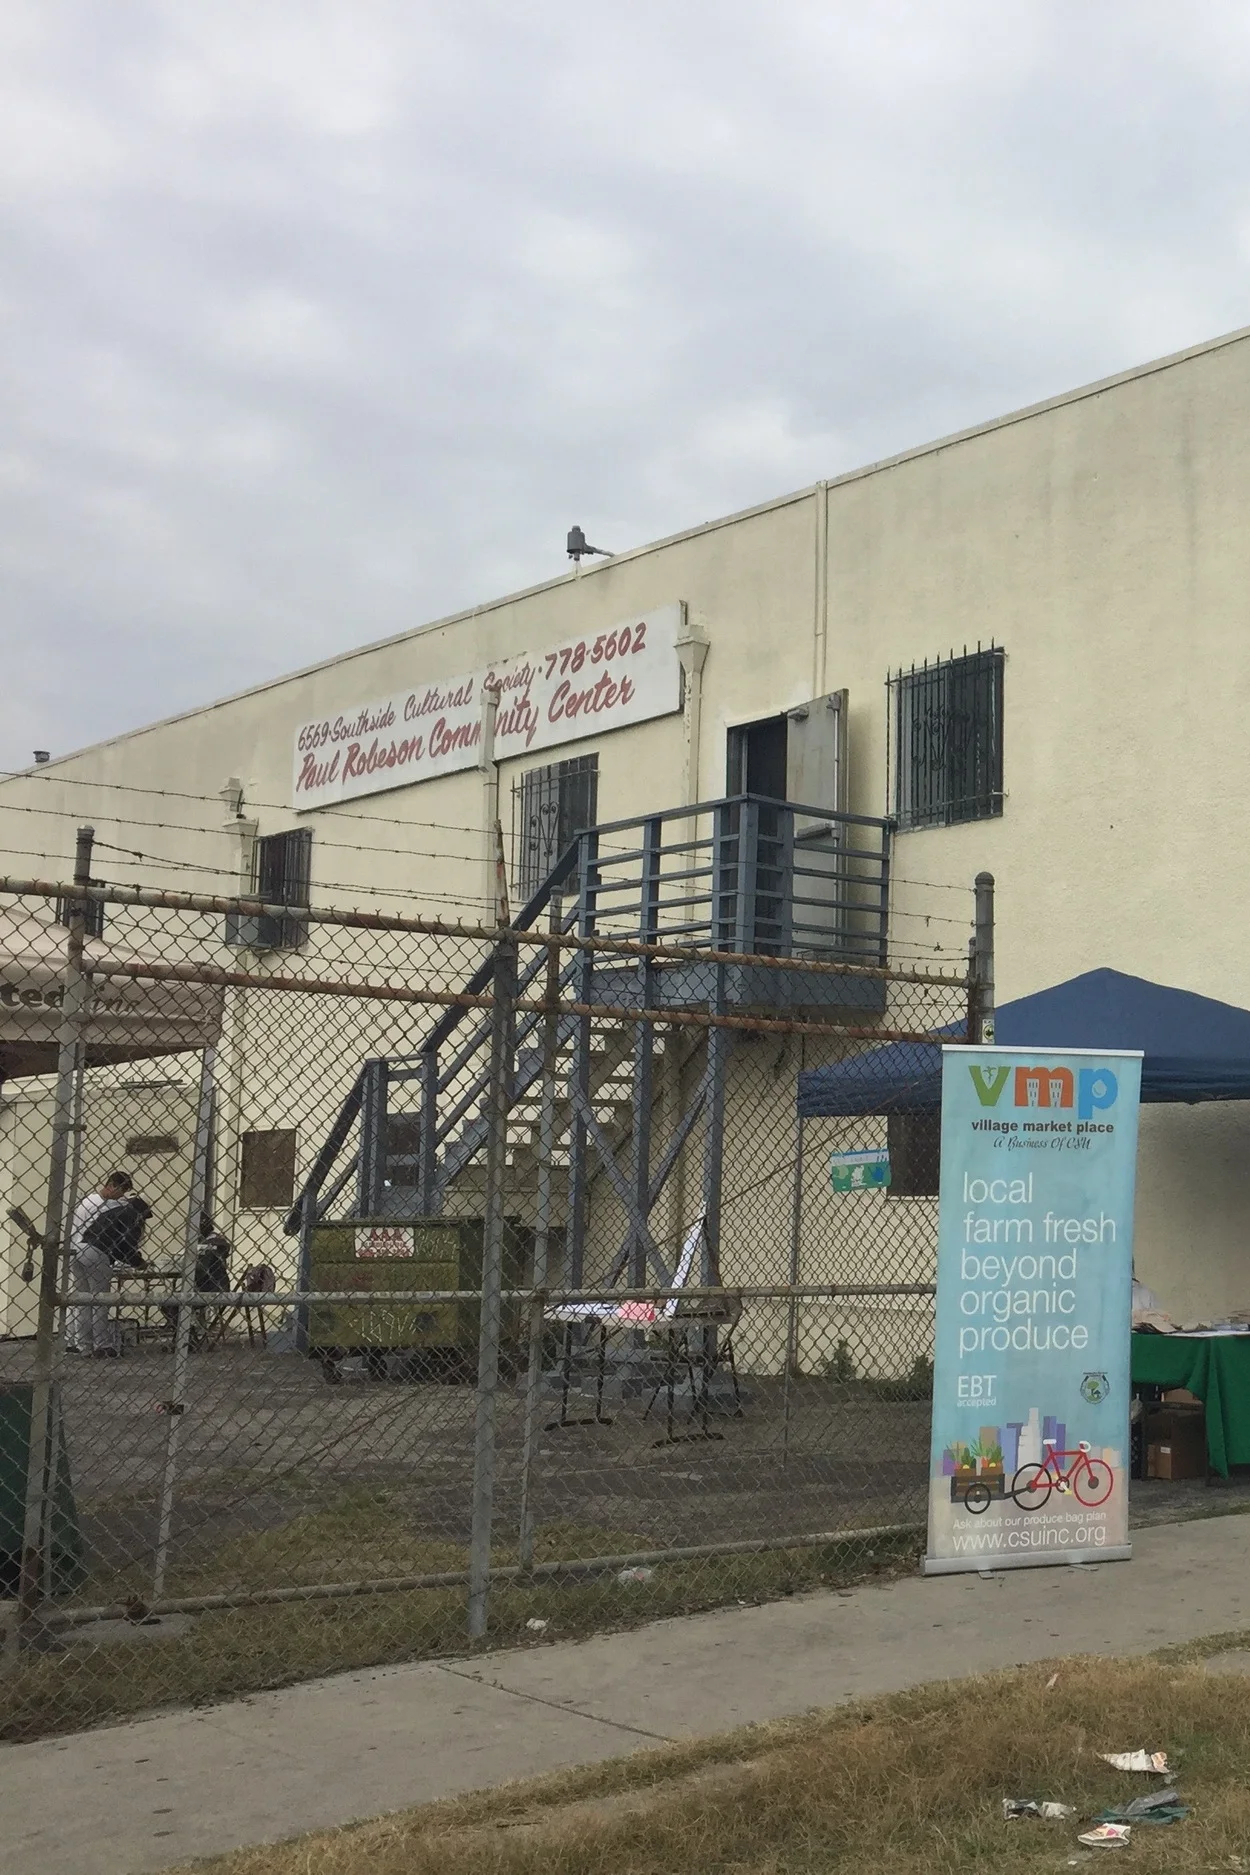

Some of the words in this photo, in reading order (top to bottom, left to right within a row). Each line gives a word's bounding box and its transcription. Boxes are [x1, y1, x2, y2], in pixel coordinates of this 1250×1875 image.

[404, 679, 473, 721] Cultural
[296, 751, 340, 792] Paul
[342, 737, 425, 785] Robeson
[428, 695, 539, 757] Commnity
[547, 669, 636, 723] Center
[968, 1065, 1119, 1120] vmp
[972, 1119, 1019, 1132] village
[1023, 1121, 1072, 1133] market
[1076, 1122, 1114, 1133] place
[1007, 1135, 1048, 1151] Business
[963, 1172, 1033, 1203] local
[963, 1211, 1033, 1243] farm
[1043, 1211, 1117, 1243] fresh
[961, 1248, 1077, 1287] beyond
[960, 1282, 1076, 1322] organic
[959, 1318, 1089, 1359] produce
[957, 1375, 997, 1397] EBT
[957, 1397, 997, 1408] accepted
[953, 1519, 971, 1529] Ask
[974, 1516, 1002, 1528] about
[1004, 1516, 1021, 1526] our
[1023, 1513, 1063, 1526] produce
[1065, 1512, 1084, 1524] bag
[1086, 1511, 1107, 1521] plan
[952, 1525, 1107, 1551] www.csuinc.org
